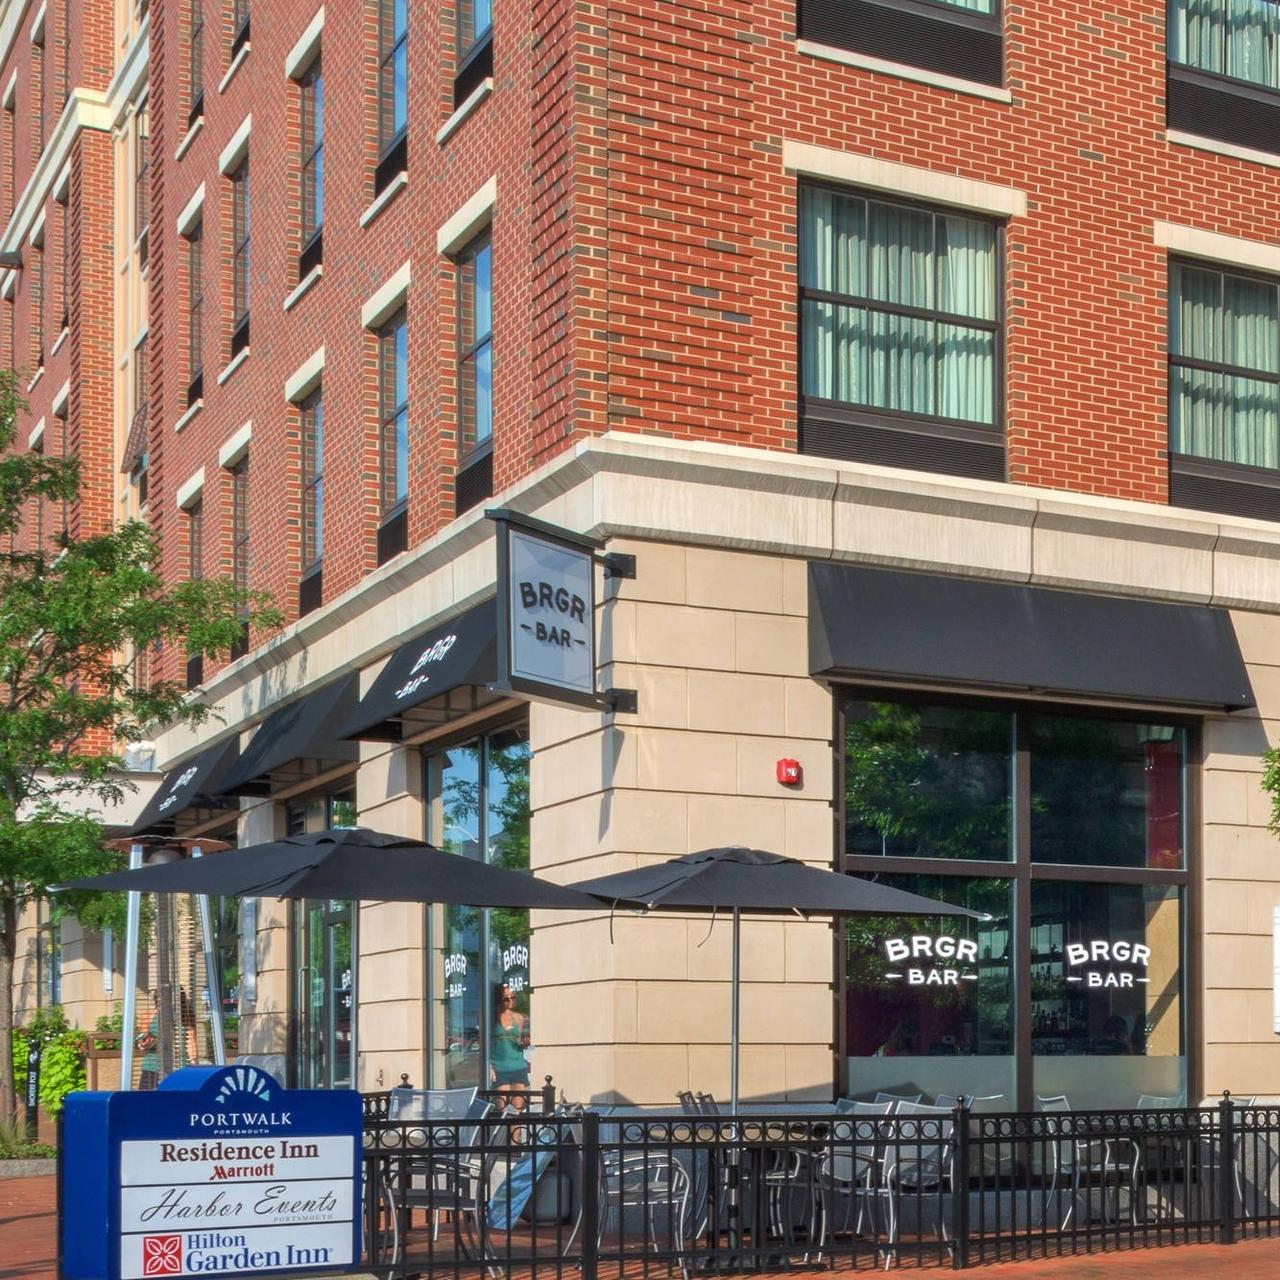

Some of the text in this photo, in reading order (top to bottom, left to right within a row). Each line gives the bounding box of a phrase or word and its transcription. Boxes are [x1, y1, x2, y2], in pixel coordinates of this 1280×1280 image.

[519, 582, 586, 623] BRGR
[535, 622, 572, 648] BAR
[503, 945, 528, 972] BRGR
[885, 935, 979, 963] BRGR
[1066, 939, 1152, 967] BRGR
[444, 953, 467, 978] BRGR
[908, 968, 959, 986] BAR
[1087, 971, 1134, 989] BAR
[190, 1112, 292, 1127] PORTWALK
[160, 1140, 319, 1163] Residence Inn
[209, 1163, 275, 1181] Marriott
[140, 1185, 338, 1222] Harbor Events
[273, 1213, 334, 1224] PORTSMOUTH
[187, 1233, 246, 1250] Hilton
[186, 1247, 282, 1273] Garden
